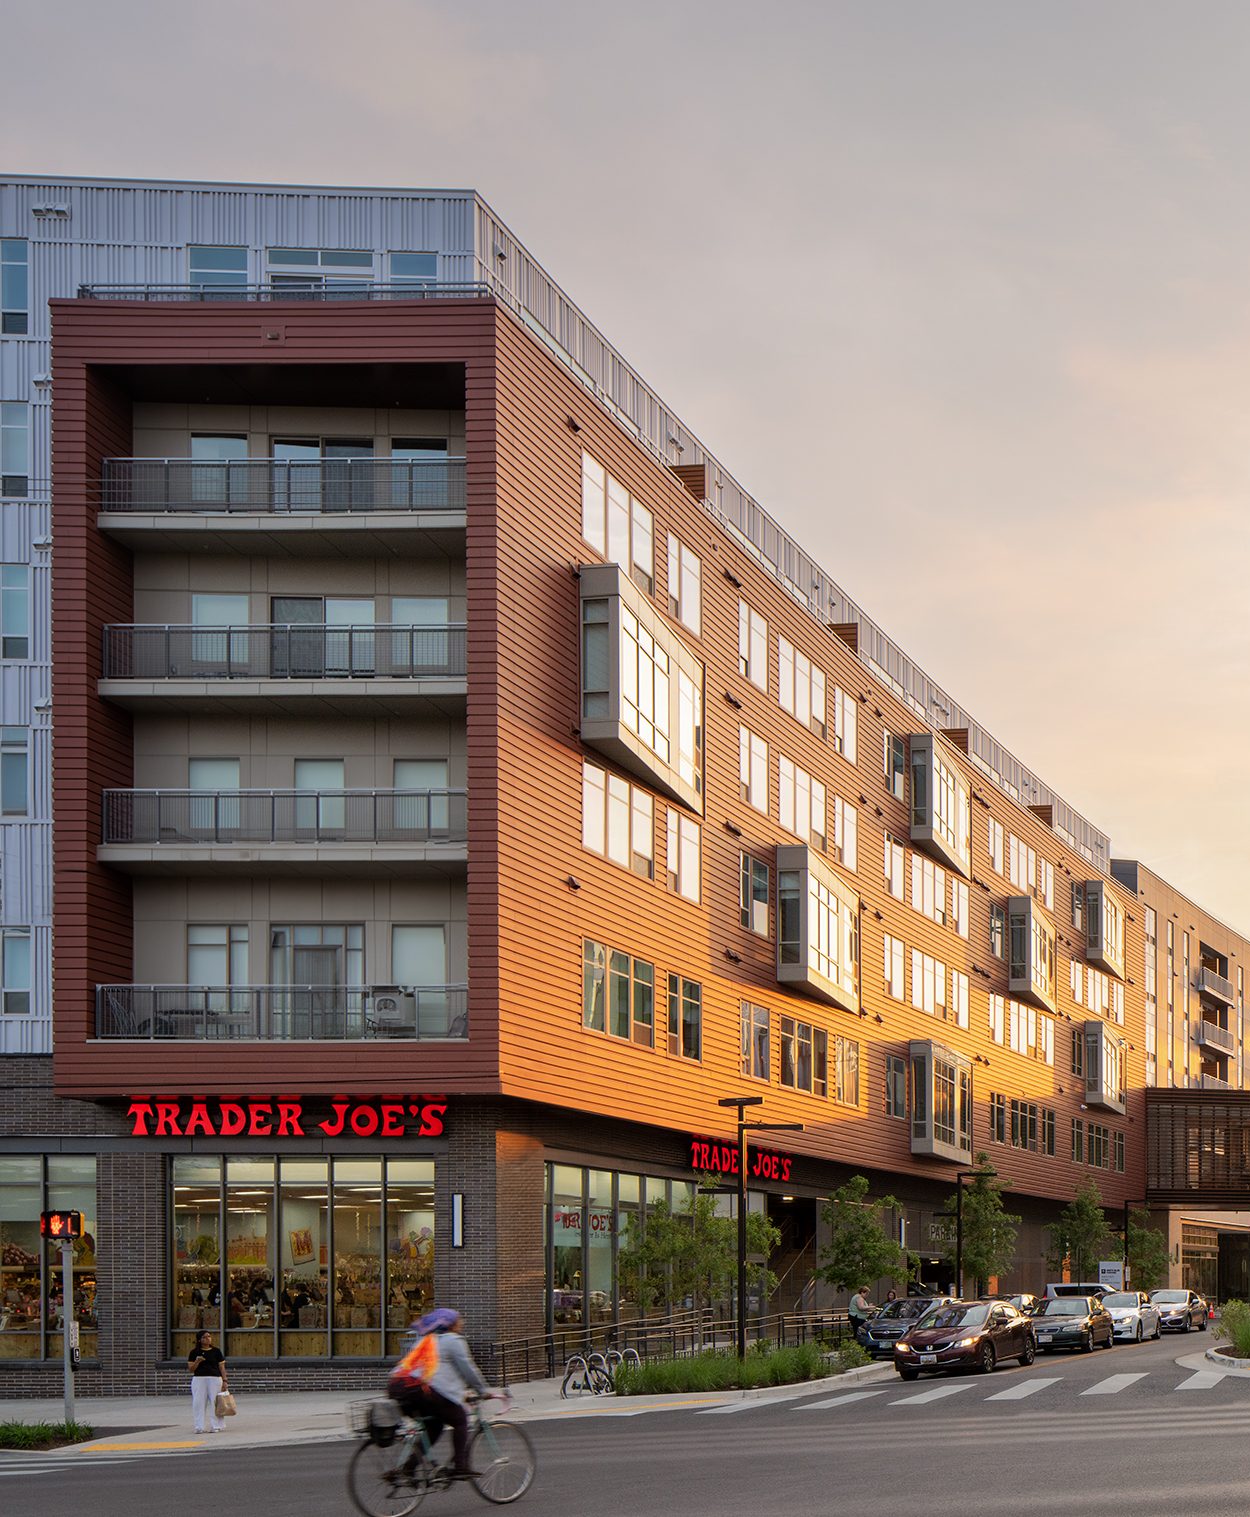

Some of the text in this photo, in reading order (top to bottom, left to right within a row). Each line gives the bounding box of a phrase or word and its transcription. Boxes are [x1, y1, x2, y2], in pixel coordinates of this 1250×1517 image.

[127, 1103, 447, 1137] TRADER JOE'S
[753, 1153, 792, 1182] JOE'S
